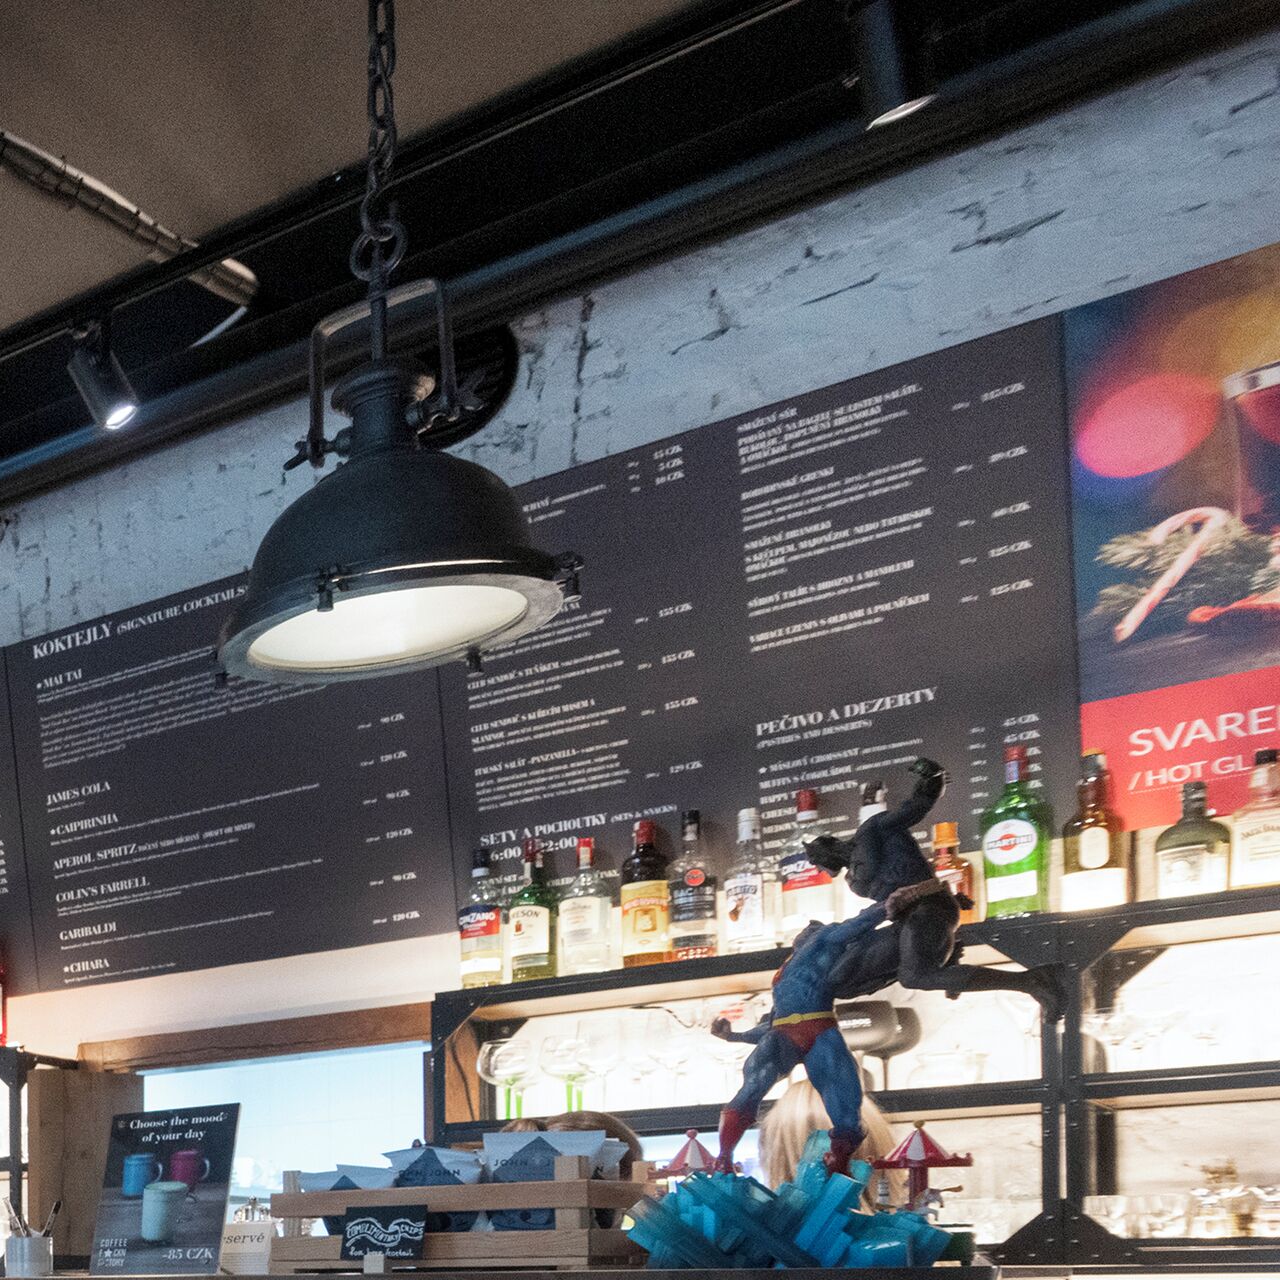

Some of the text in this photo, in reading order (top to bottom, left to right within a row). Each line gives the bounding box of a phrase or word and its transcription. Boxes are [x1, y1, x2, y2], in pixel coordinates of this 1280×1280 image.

[675, 602, 693, 614] CZK
[33, 621, 113, 660] KOKTEJLY
[678, 649, 696, 661] CZK
[43, 668, 83, 689] MAI TAI
[681, 696, 699, 708] CZK
[756, 686, 938, 737] PEČIVO A DEZERTY
[685, 759, 703, 771] CZK
[1144, 754, 1252, 788] HOT GL
[46, 781, 111, 806] JAMES COLA
[56, 813, 119, 837] CAIPIRINHA
[480, 829, 520, 847] SETY
[521, 829, 532, 839] A
[534, 813, 608, 838] POCHOUTKY
[53, 853, 96, 871] APEROL
[96, 843, 138, 861] SPRITZ
[100, 876, 151, 895] FARRELL
[59, 922, 117, 941] GARIBALDI
[69, 958, 111, 974] CHIARA
[129, 1111, 224, 1130] Choose the mood
[141, 1129, 207, 1144] of your day
[100, 1238, 128, 1248] COFFEE
[186, 1247, 215, 1260] CZK
